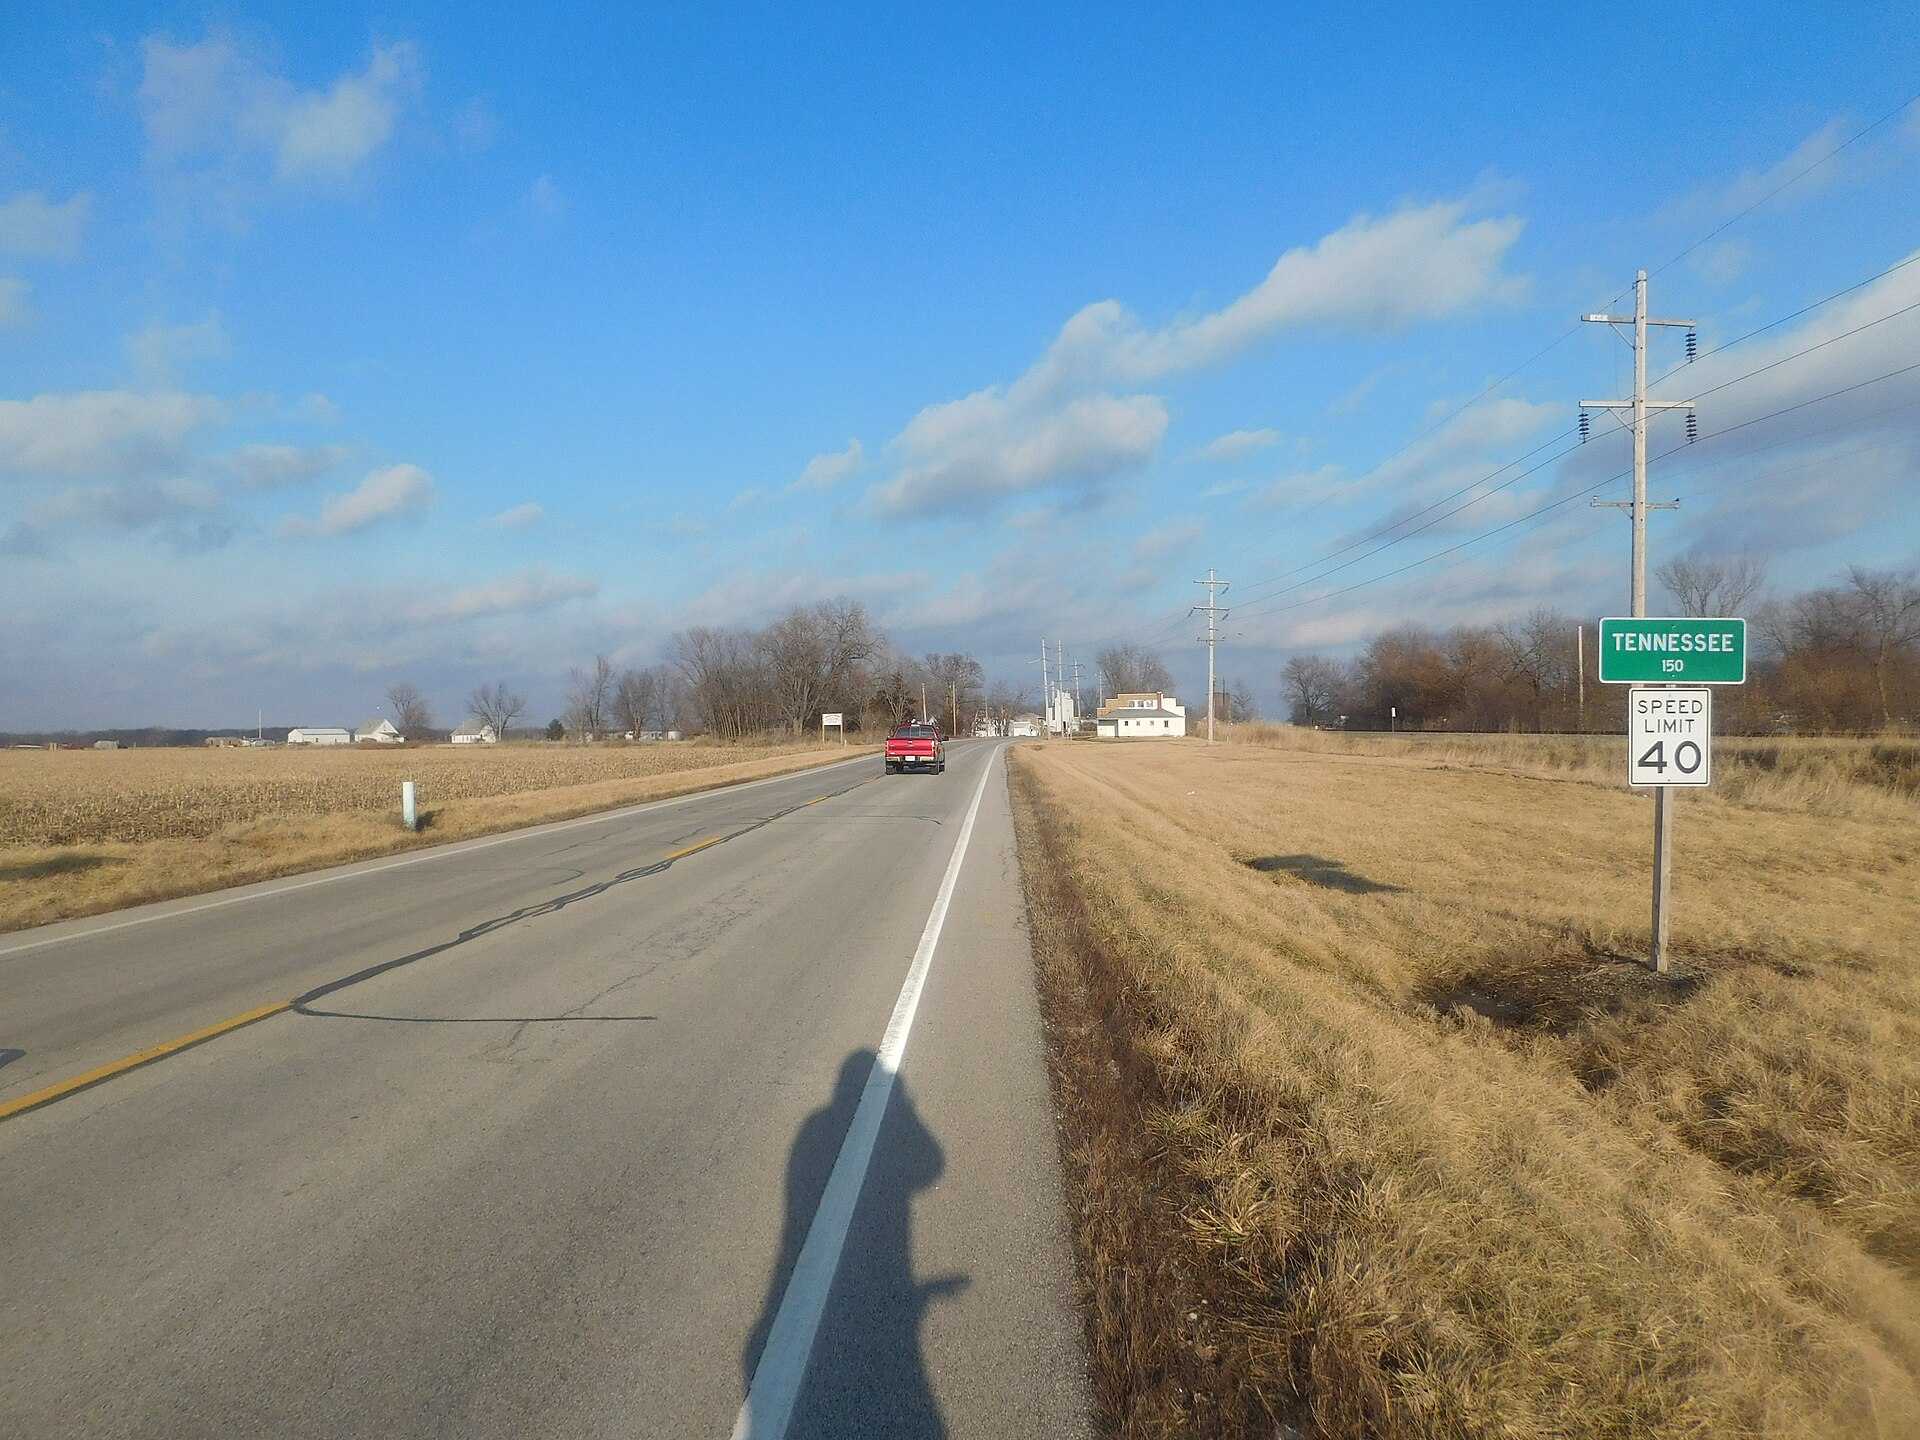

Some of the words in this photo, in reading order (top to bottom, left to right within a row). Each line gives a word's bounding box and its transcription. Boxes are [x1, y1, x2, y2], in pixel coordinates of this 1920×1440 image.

[1612, 633, 1734, 652] TENNESSEE
[1662, 660, 1684, 672] 150
[1637, 700, 1703, 714] SPEED
[1645, 719, 1695, 733] LIMIT
[1637, 740, 1702, 774] 40
